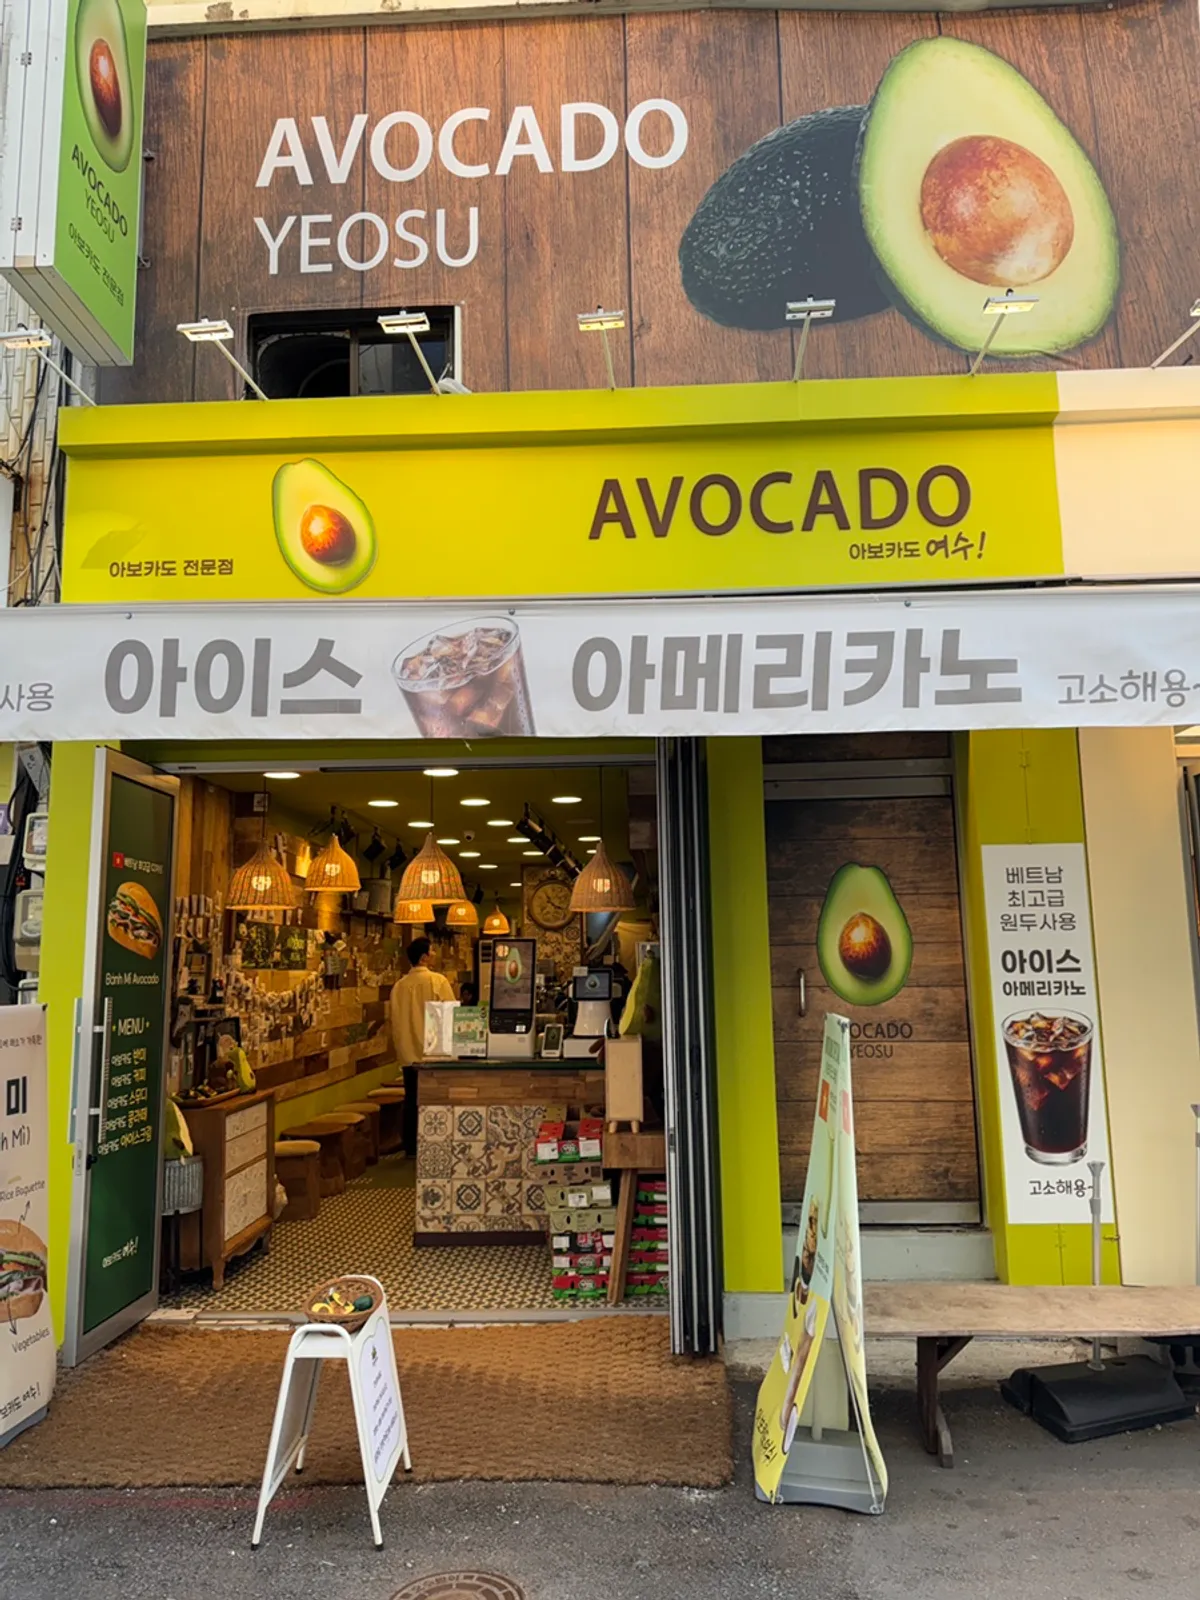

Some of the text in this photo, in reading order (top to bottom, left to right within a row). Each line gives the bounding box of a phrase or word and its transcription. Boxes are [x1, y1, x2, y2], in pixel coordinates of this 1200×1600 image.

[255, 98, 689, 189] AVOCADO
[71, 144, 128, 237] AVOCADO
[85, 188, 115, 244] YEOSU
[69, 222, 101, 276] 아보카도
[253, 206, 480, 275] YEOSU
[588, 464, 972, 541] AVOCADO
[849, 531, 987, 561] 아보카도 여수!
[109, 558, 234, 578] 아보카도 전문점
[103, 637, 364, 718] 아이스
[572, 628, 1023, 715] 아메리카노
[0, 682, 54, 712] 사용
[1005, 866, 1064, 885] 베트남
[1007, 889, 1066, 908] 최고급
[1001, 949, 1082, 975] 아이스
[1002, 980, 1087, 997] 아메리카노
[117, 1017, 145, 1037] MENU
[849, 1022, 913, 1039] OCADO
[11, 1326, 51, 1353] Vegetables
